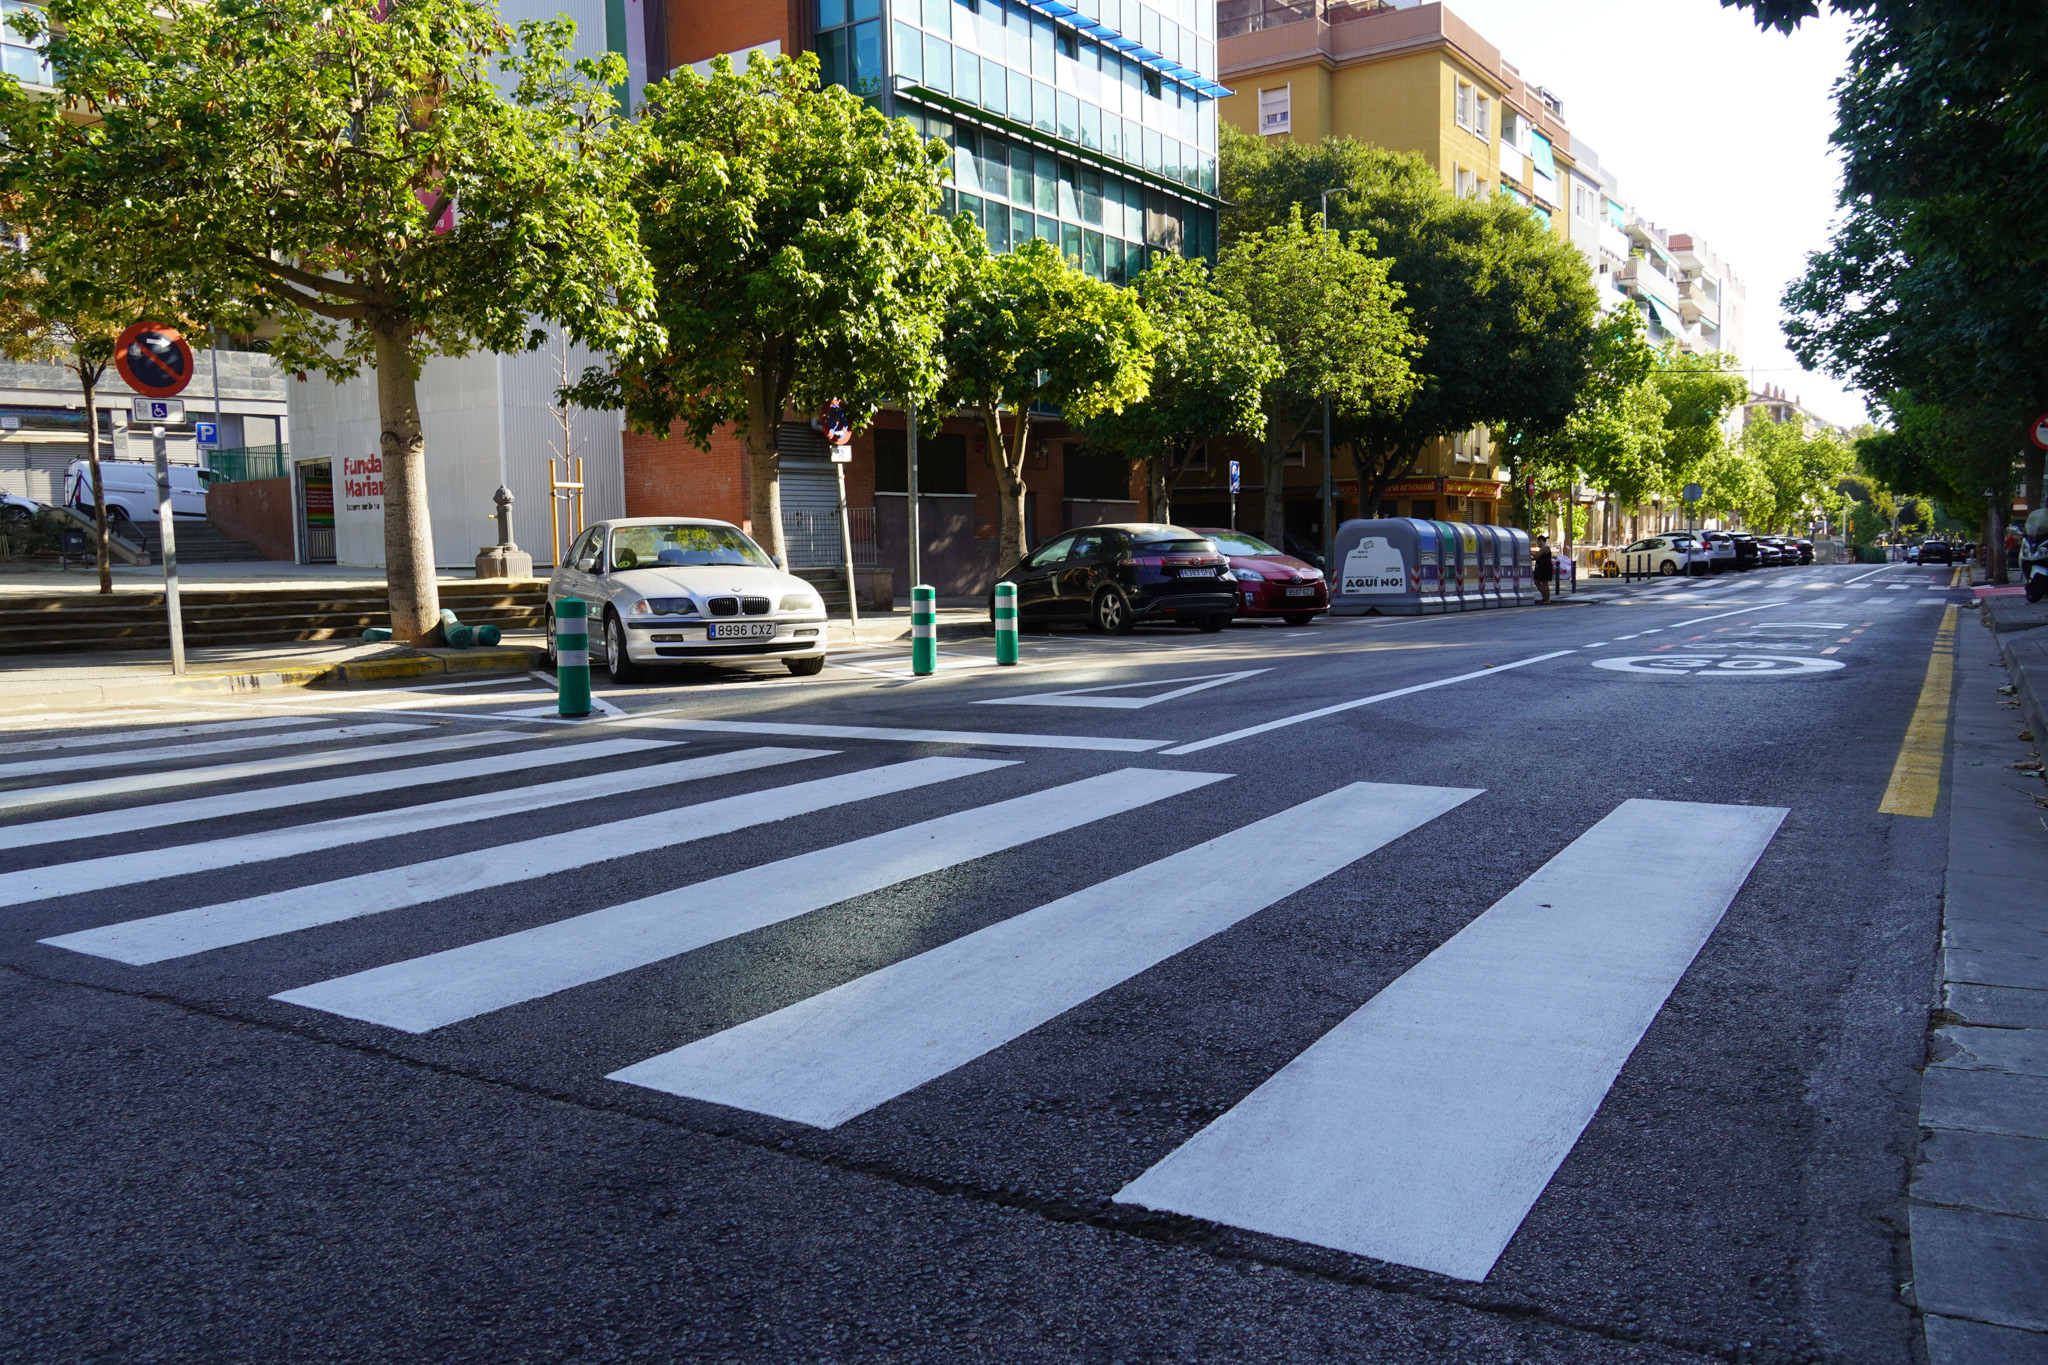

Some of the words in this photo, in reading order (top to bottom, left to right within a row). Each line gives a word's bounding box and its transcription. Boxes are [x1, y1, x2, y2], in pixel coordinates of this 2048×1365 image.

[201, 425, 214, 441] P
[1345, 576, 1378, 587] AQUÍ
[1380, 578, 1403, 587] NO!
[718, 625, 747, 636] 8996
[751, 624, 772, 635] CXZ
[1649, 659, 1777, 669] 30
